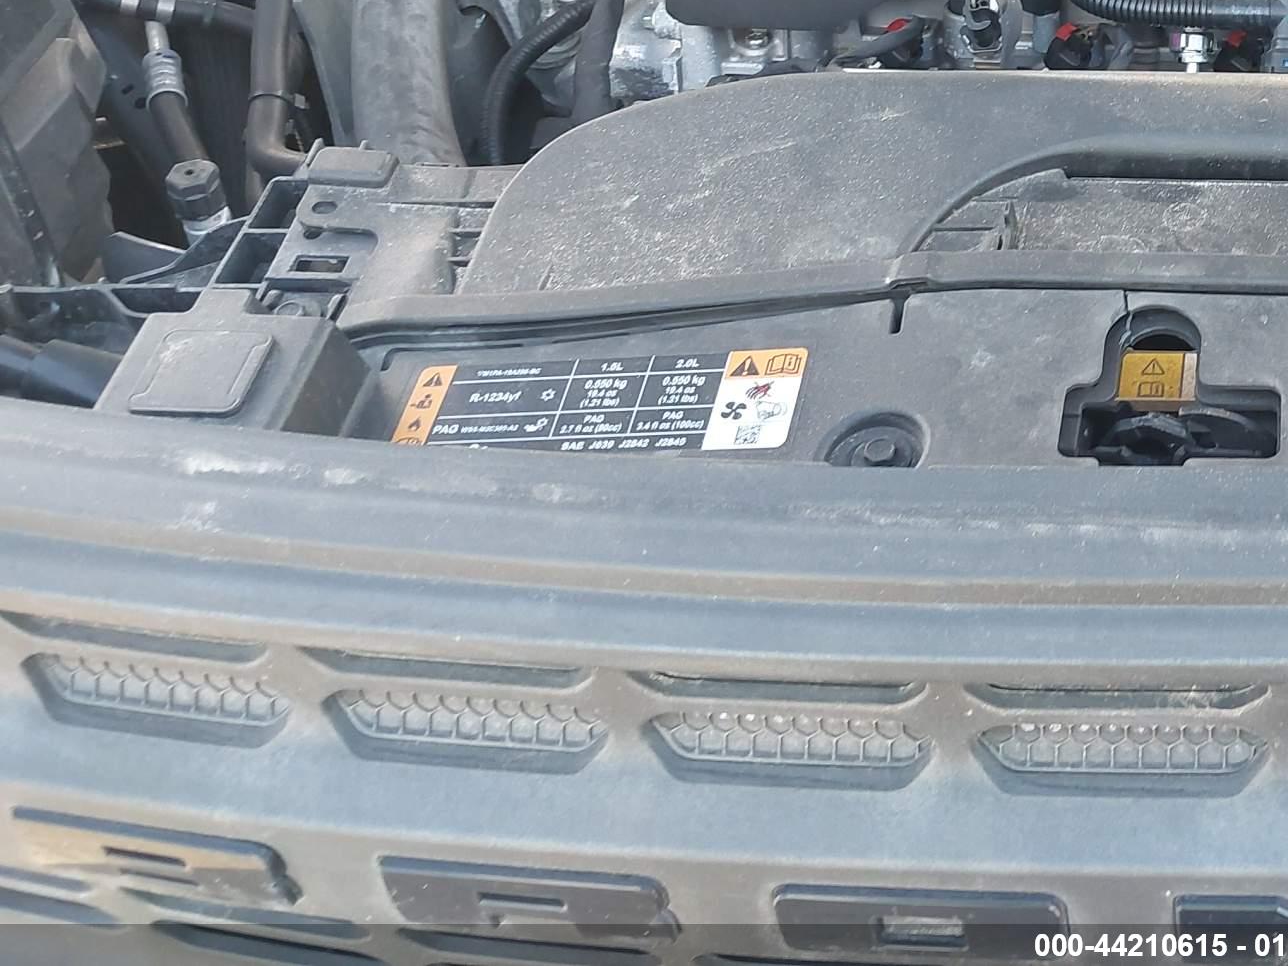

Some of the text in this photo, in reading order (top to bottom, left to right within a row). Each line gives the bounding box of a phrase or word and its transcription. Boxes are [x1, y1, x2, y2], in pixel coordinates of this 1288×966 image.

[674, 358, 700, 369] 2.0L
[614, 378, 628, 390] kg
[691, 374, 707, 386] kg
[432, 424, 460, 435] PAG
